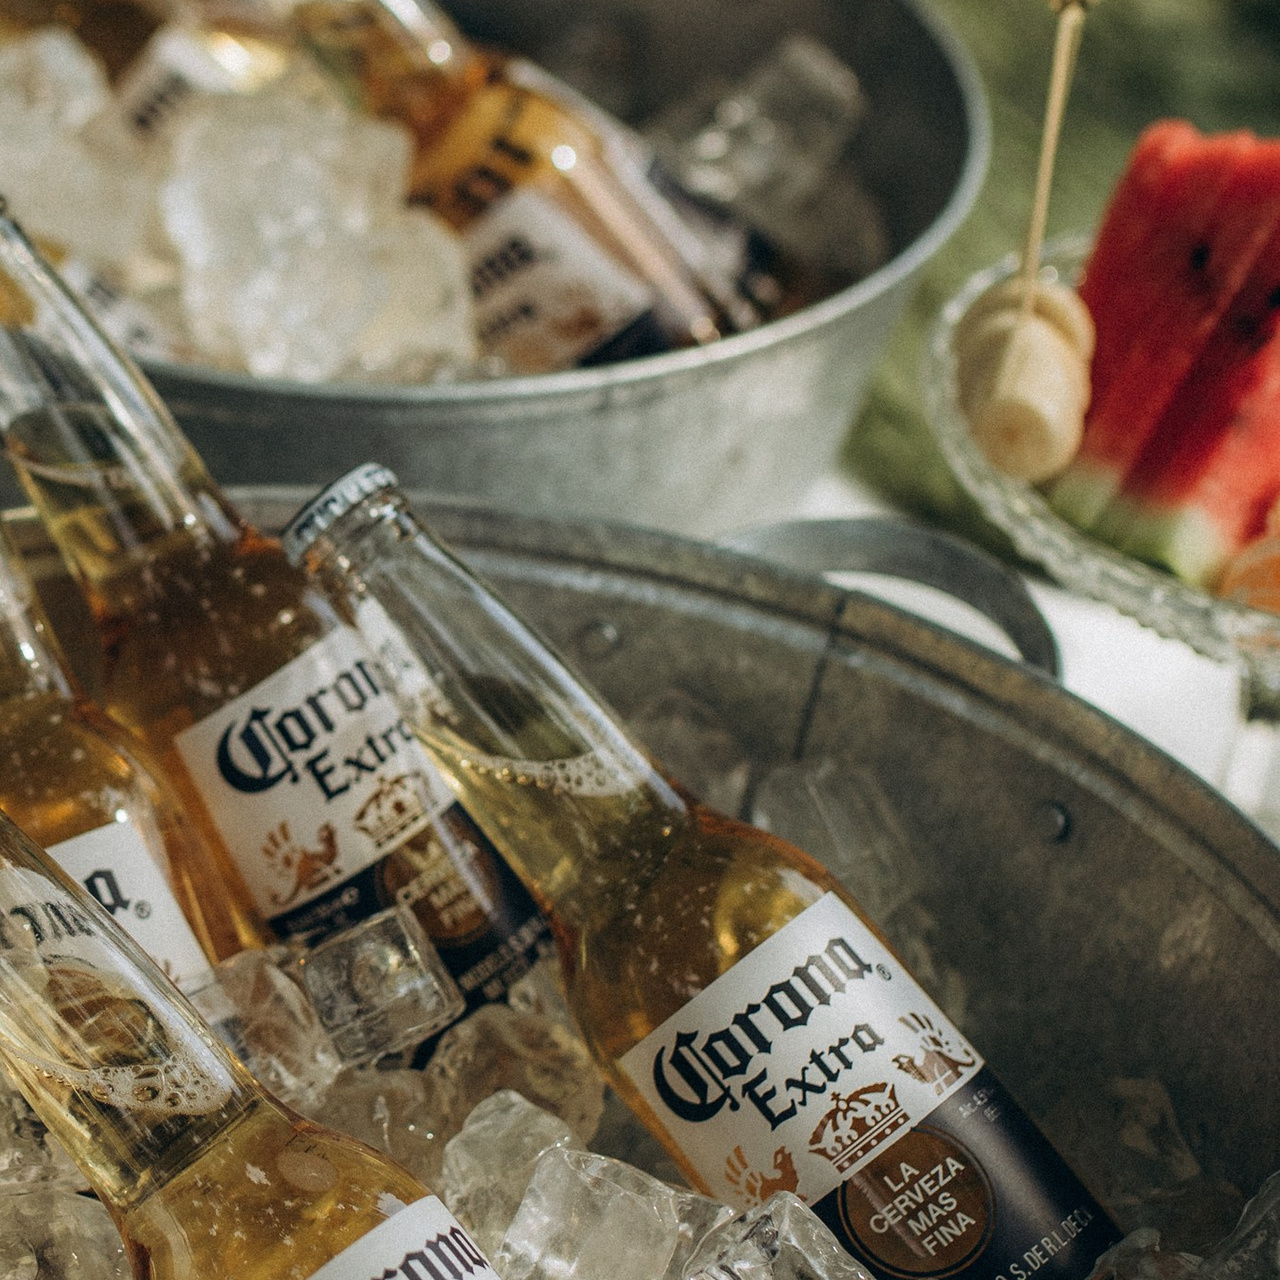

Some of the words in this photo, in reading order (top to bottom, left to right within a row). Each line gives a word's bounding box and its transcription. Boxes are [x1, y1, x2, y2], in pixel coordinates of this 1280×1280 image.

[217, 660, 394, 793] Coron
[653, 936, 874, 1123] Corona
[741, 1022, 885, 1132] Extra
[870, 1156, 966, 1234] CERVEZA
[883, 1162, 920, 1193] LA
[907, 1191, 958, 1236] MAS
[921, 1211, 977, 1257] FINA
